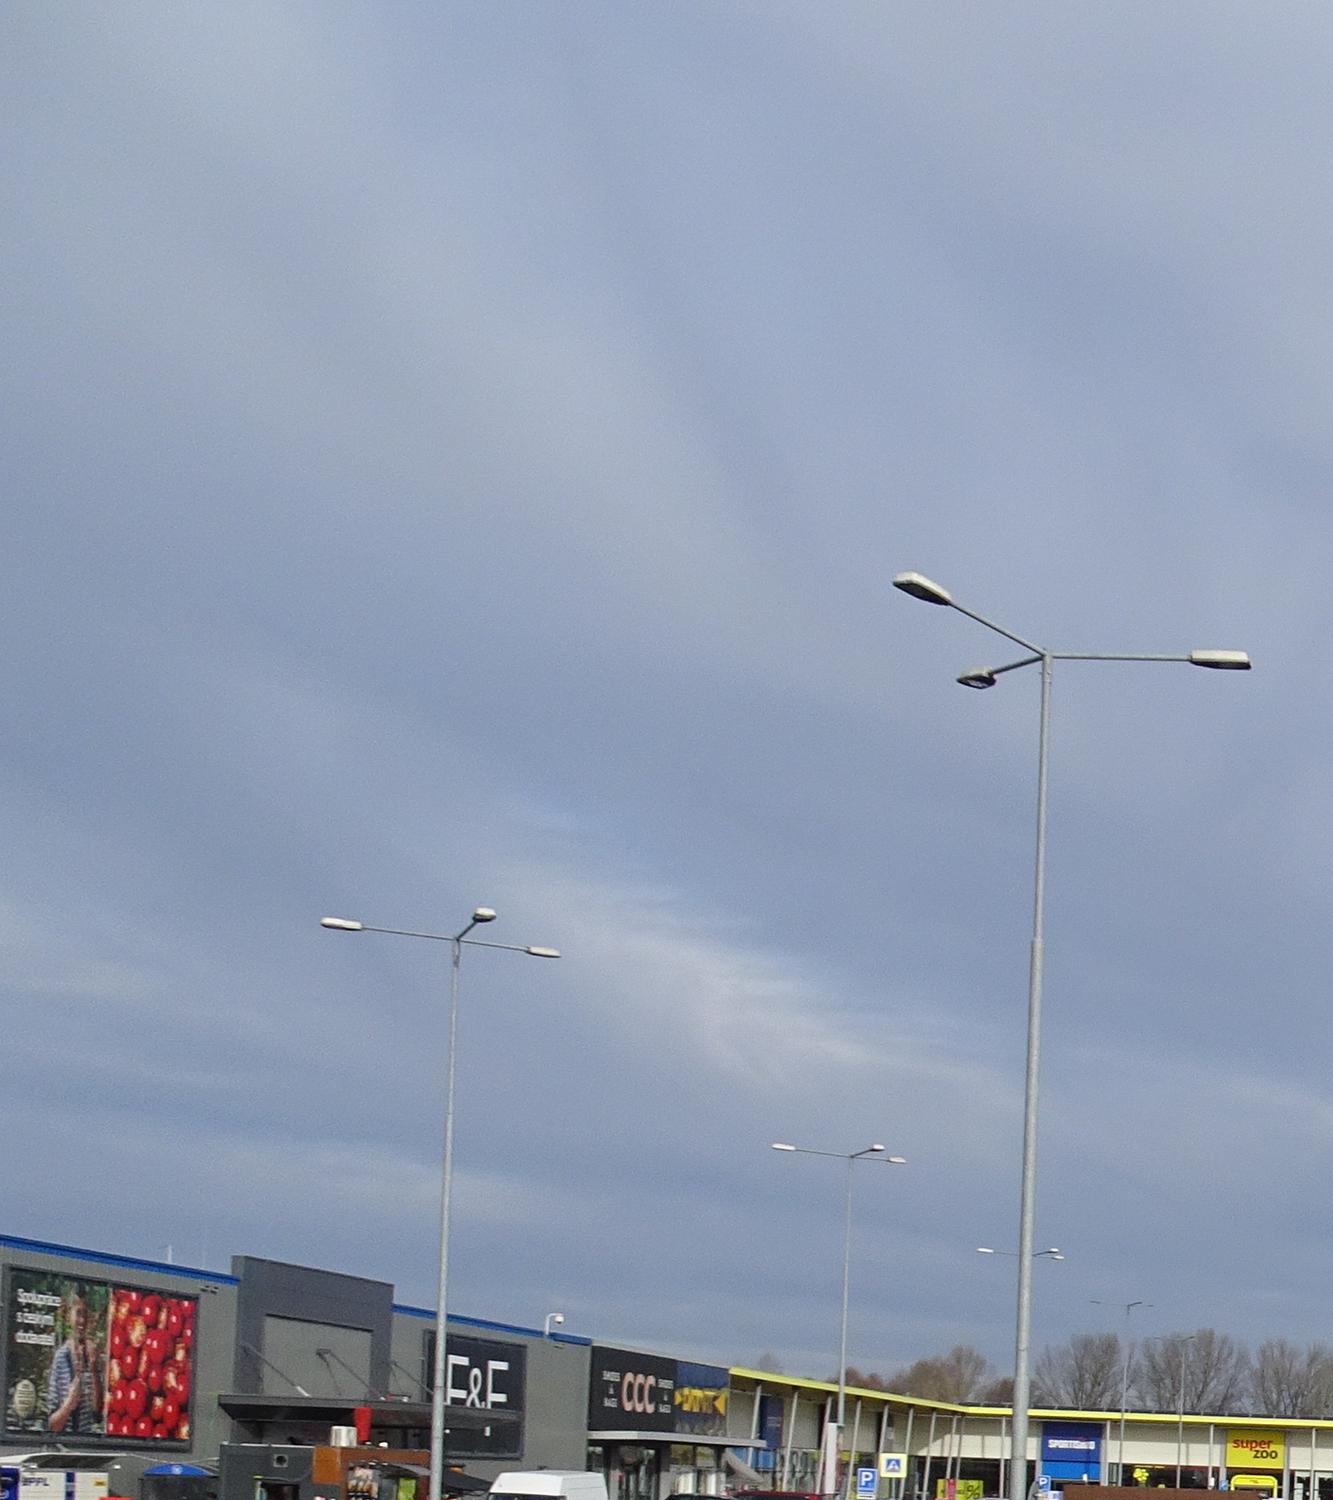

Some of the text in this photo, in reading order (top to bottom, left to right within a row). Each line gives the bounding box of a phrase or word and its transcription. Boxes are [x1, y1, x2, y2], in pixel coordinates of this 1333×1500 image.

[446, 1354, 508, 1409] F&F
[621, 1371, 656, 1413] CCC
[1232, 1439, 1274, 1451] super
[861, 1471, 873, 1486] P
